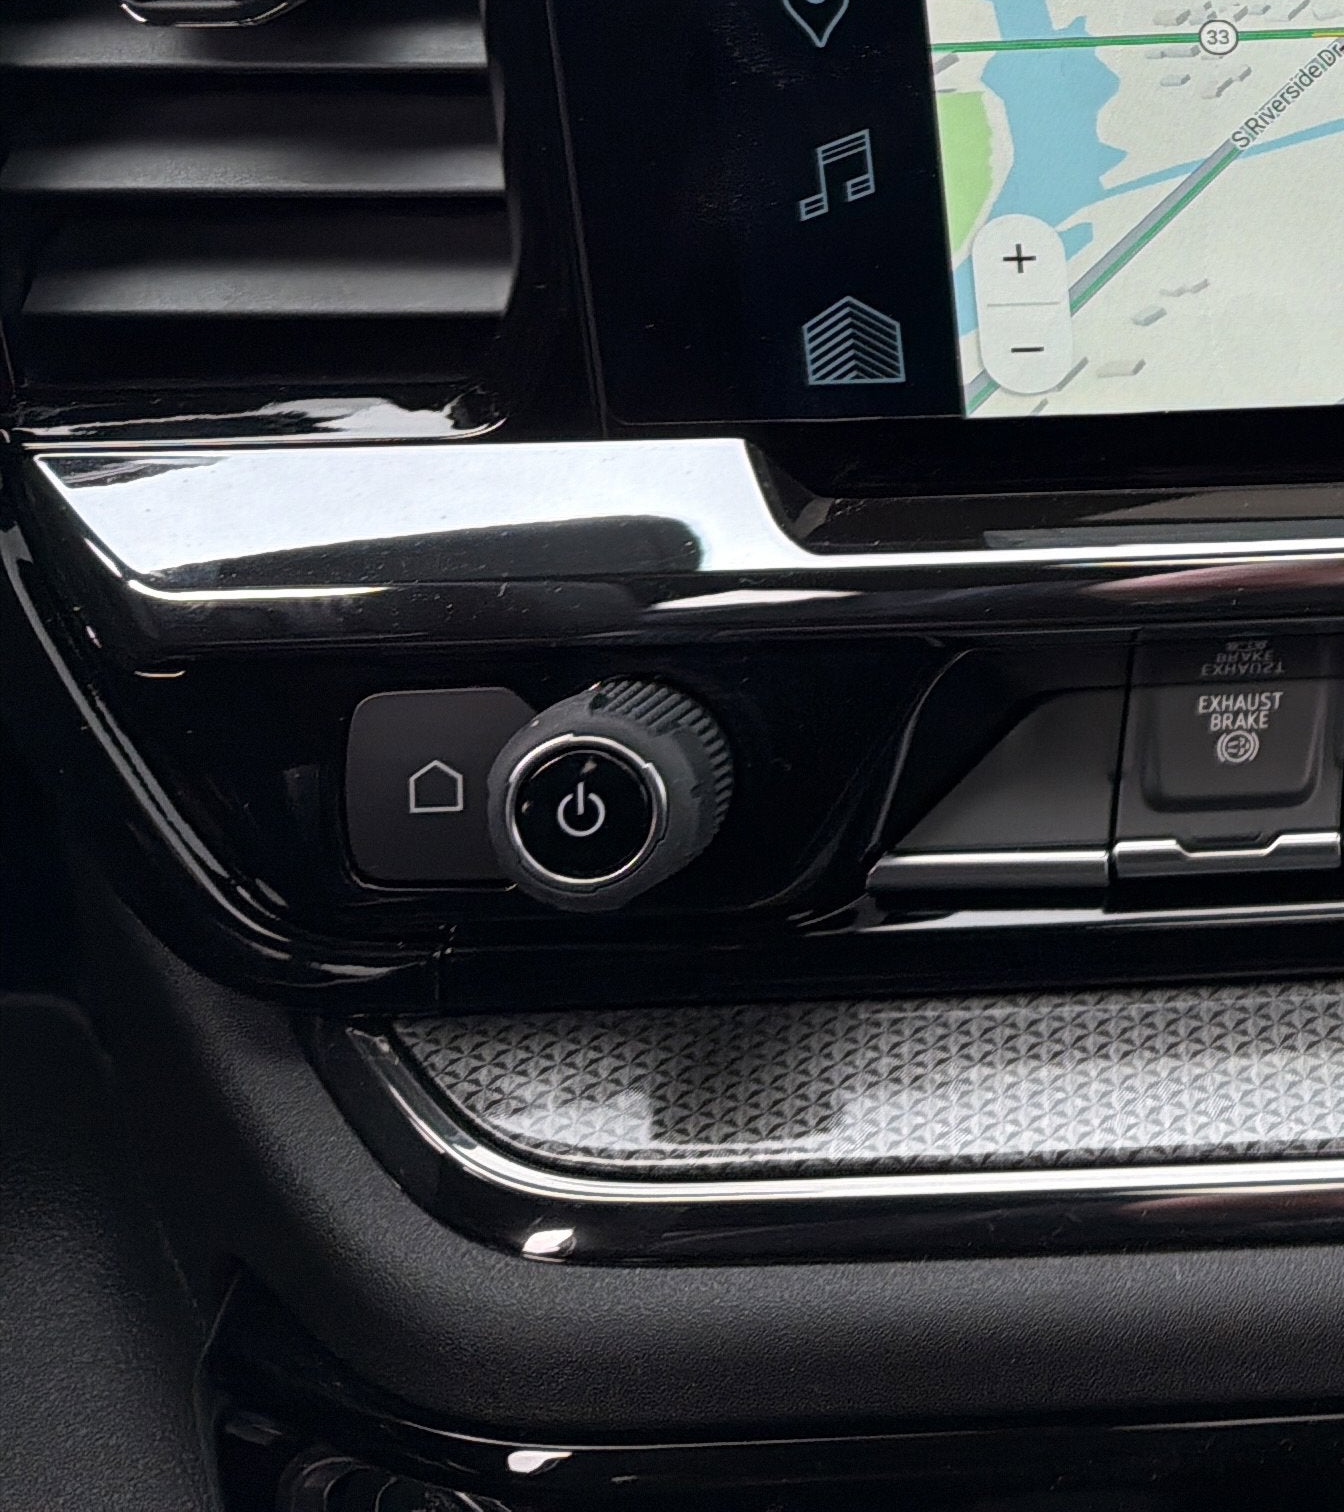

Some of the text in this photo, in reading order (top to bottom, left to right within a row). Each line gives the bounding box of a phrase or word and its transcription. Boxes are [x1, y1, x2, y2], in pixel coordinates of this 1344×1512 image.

[1206, 27, 1231, 48] 33
[1230, 41, 1343, 150] S Riverside Dr
[1198, 691, 1284, 713] EXHAUST
[1210, 711, 1269, 731] BRAKE
